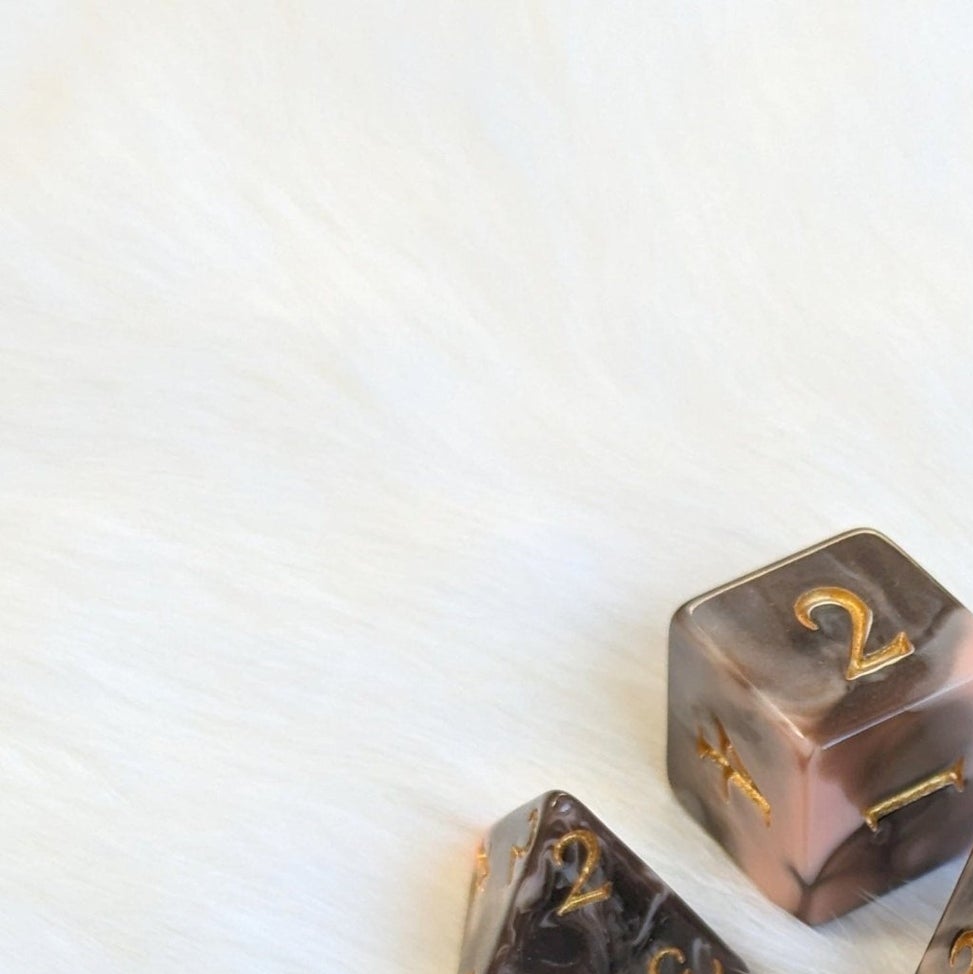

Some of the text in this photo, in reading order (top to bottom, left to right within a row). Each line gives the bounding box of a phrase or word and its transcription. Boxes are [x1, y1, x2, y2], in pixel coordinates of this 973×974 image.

[793, 586, 915, 680] 2
[864, 757, 966, 832] 1
[552, 829, 613, 917] 2
